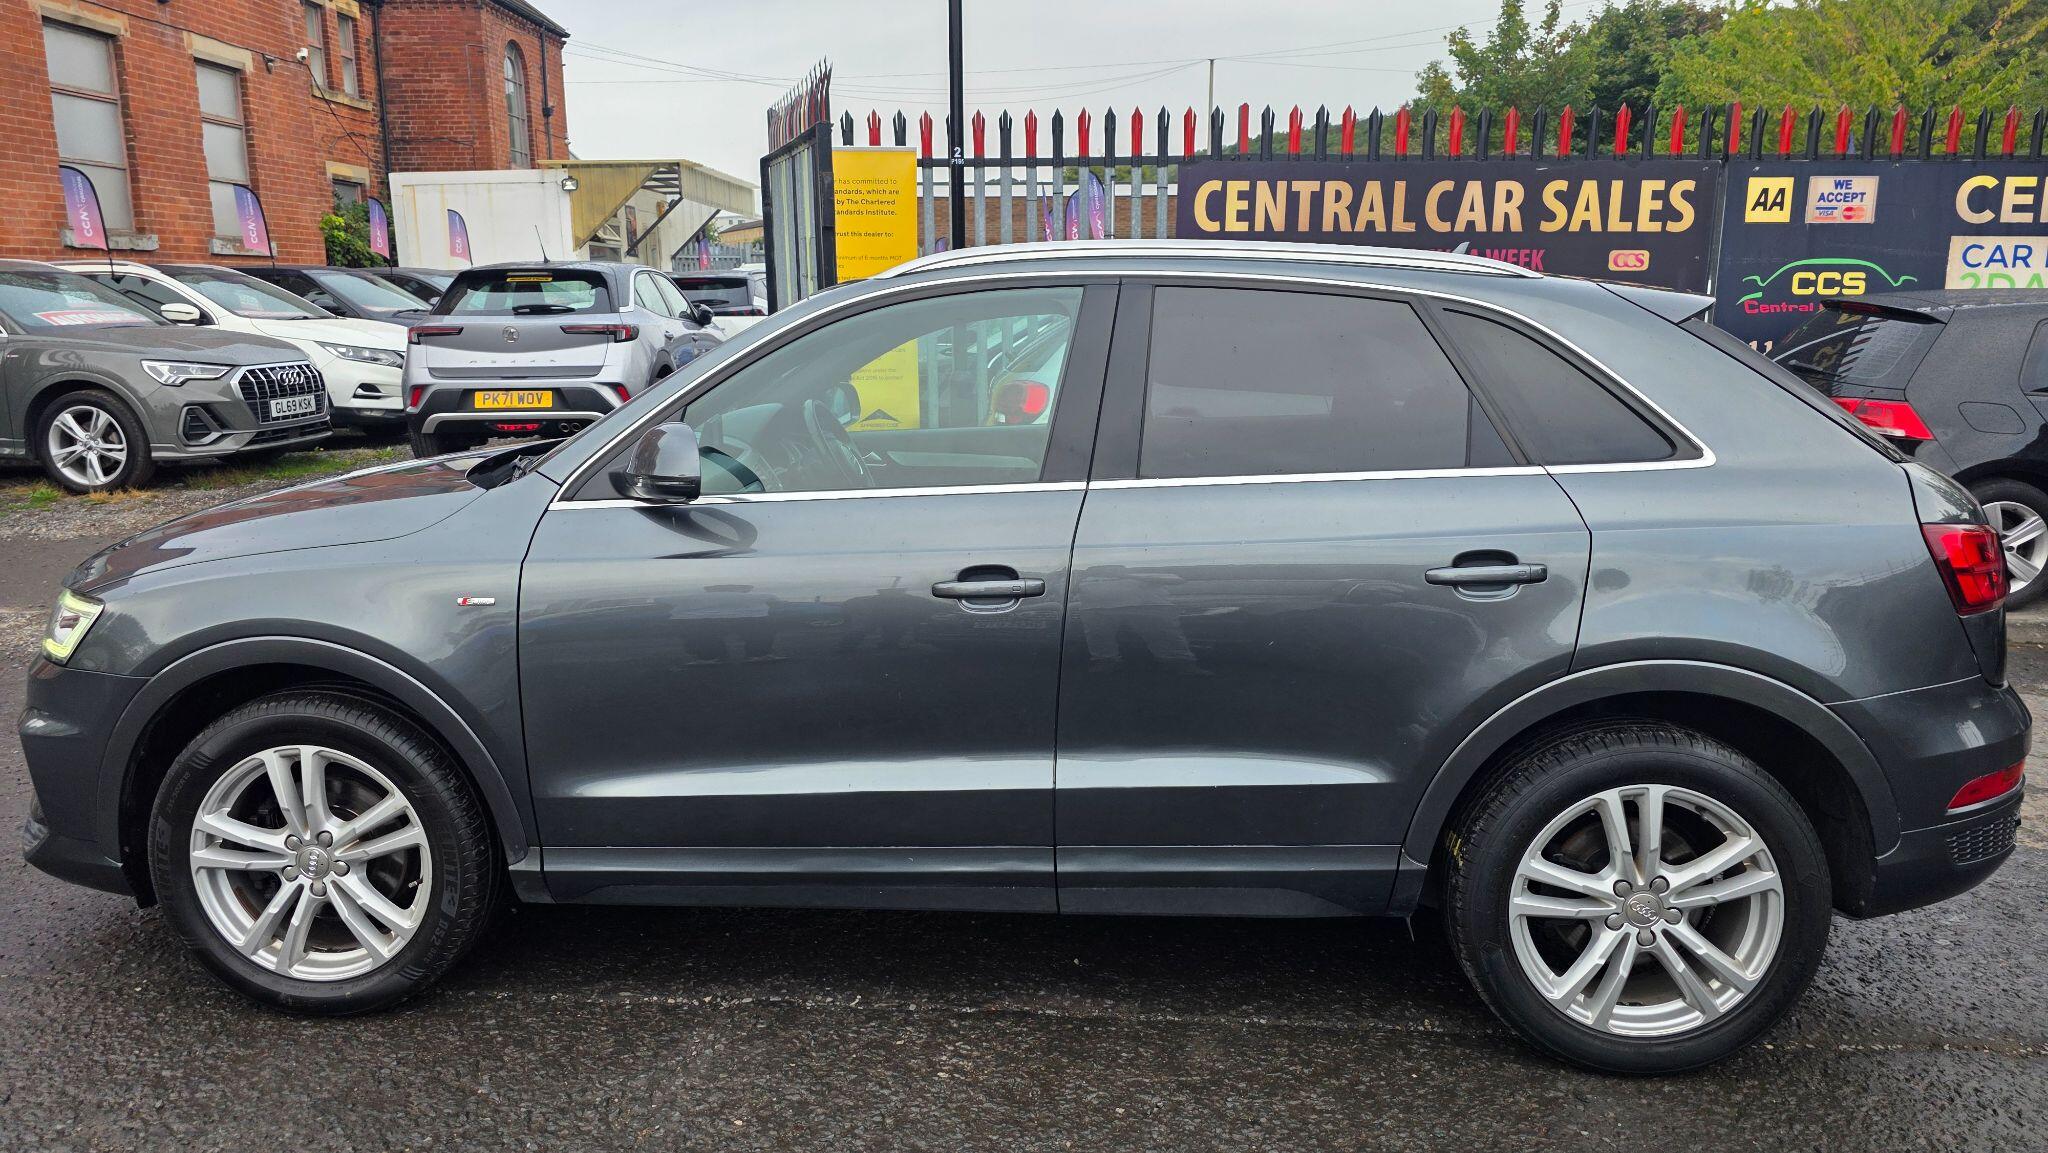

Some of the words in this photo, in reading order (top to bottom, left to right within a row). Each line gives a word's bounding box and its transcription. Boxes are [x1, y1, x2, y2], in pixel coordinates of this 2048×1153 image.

[953, 146, 962, 158] 2
[1833, 179, 1853, 190] WE
[836, 198, 845, 207] by
[860, 198, 896, 206] Chartered
[1751, 187, 1786, 212] AA
[1817, 192, 1867, 203] ACCEPT
[1955, 175, 2048, 224] CE
[836, 208, 864, 216] andards
[1193, 179, 1417, 232] CENTRAL
[1424, 180, 1525, 233] CAR
[1539, 179, 1696, 233] SALES
[1612, 252, 1647, 269] CCS
[1961, 243, 2033, 268] CAR
[1791, 271, 1867, 296] CCS
[1743, 300, 1814, 314] Central
[275, 399, 297, 414] GL69
[298, 398, 313, 410] KSK
[482, 392, 513, 405] PK71
[517, 392, 544, 405] WOV
